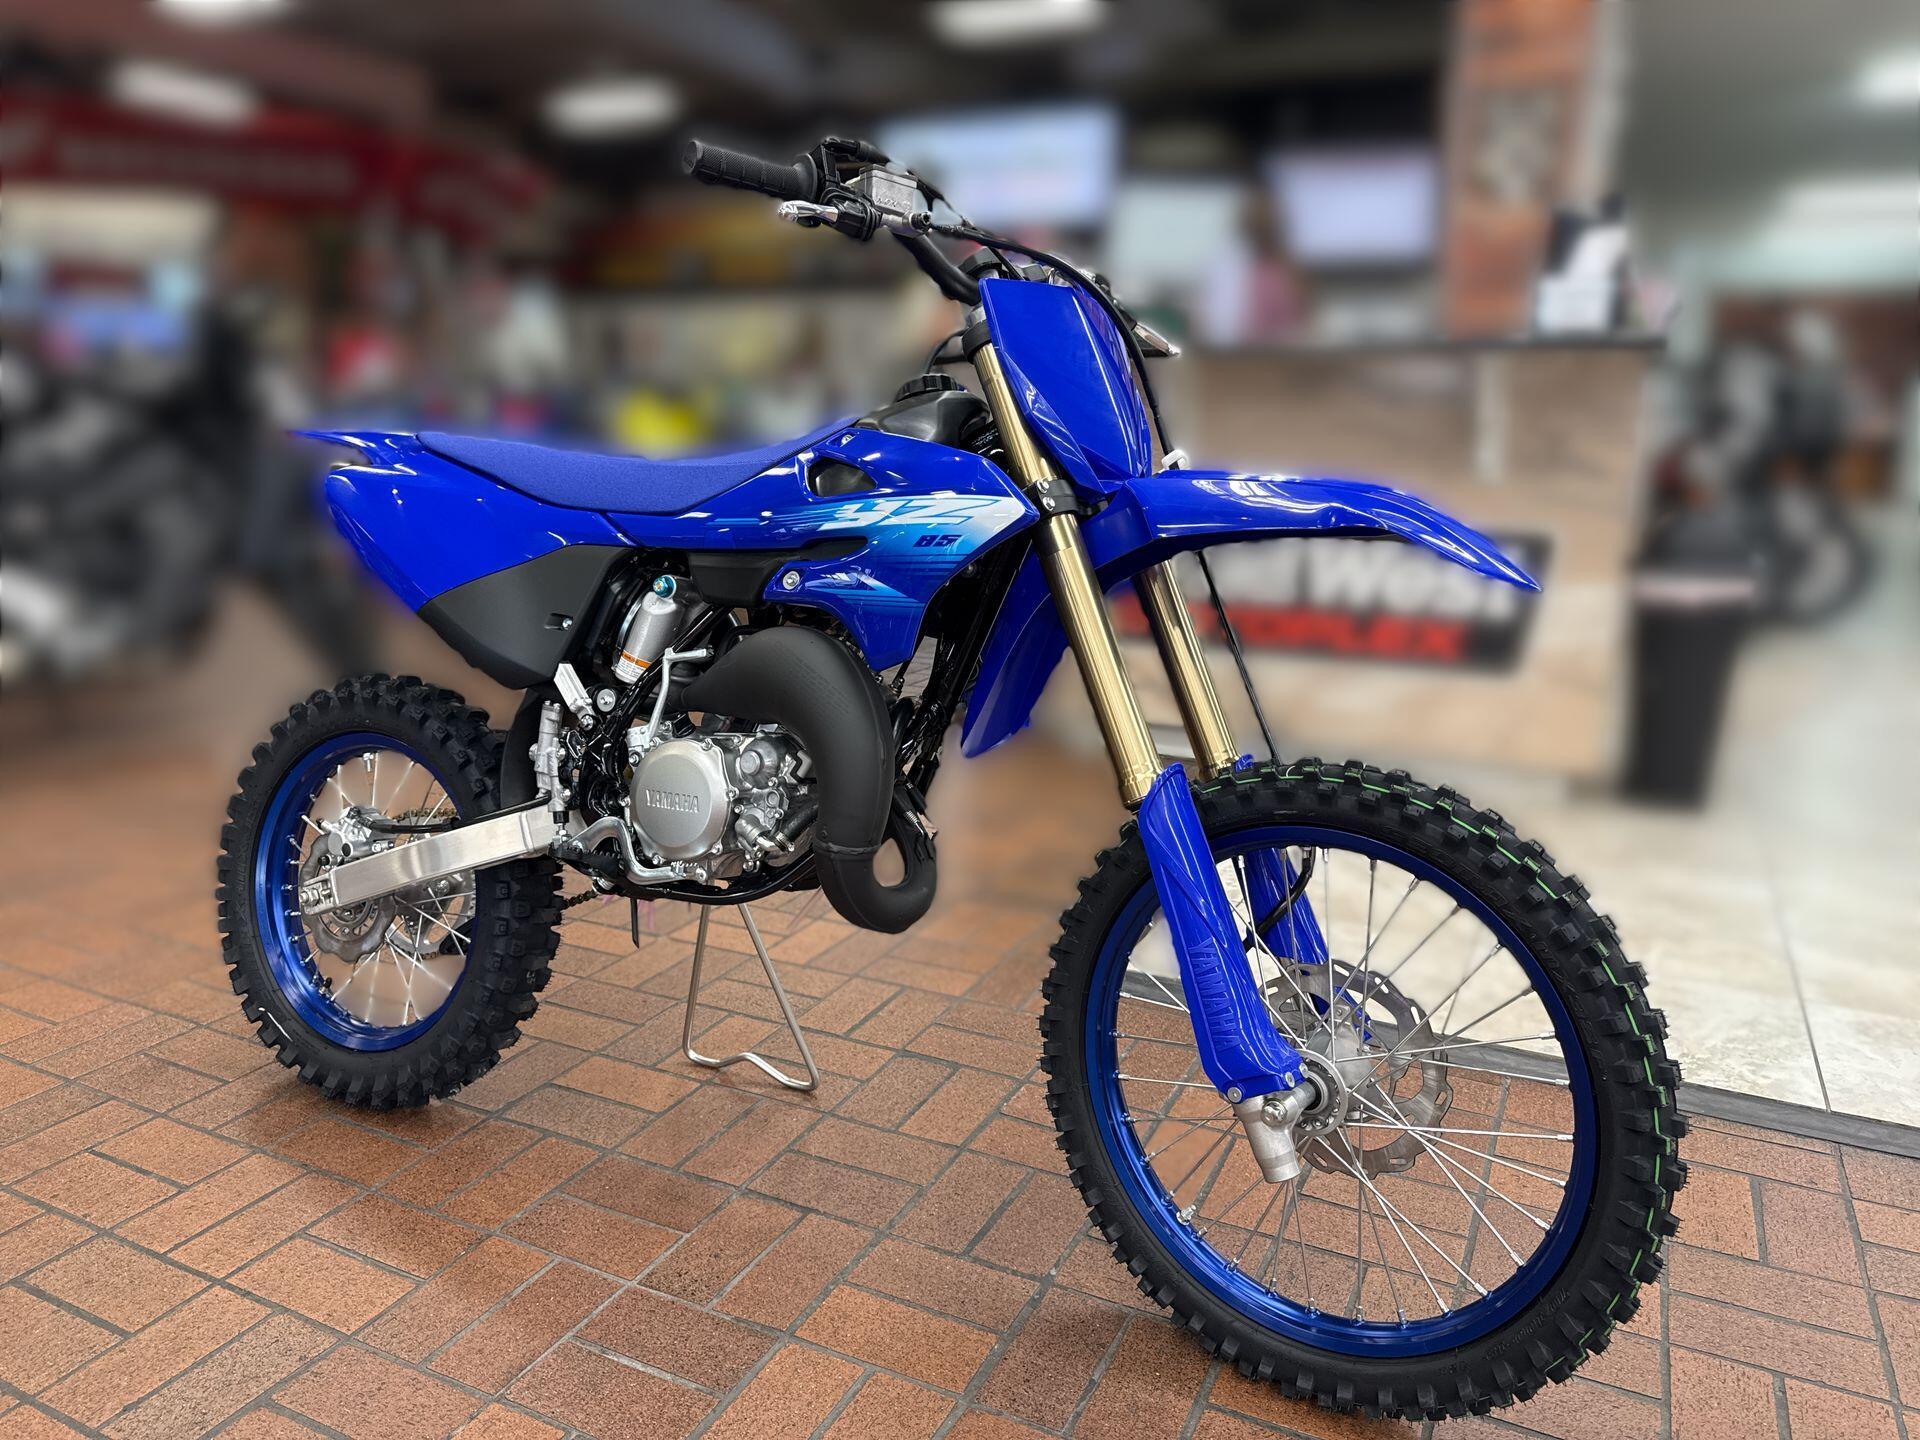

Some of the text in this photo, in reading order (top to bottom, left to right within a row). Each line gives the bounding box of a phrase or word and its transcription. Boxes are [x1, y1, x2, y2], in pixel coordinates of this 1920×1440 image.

[912, 534, 963, 548] 85
[645, 788, 701, 814] YAMAHA
[1187, 936, 1242, 1052] YAMAHA
